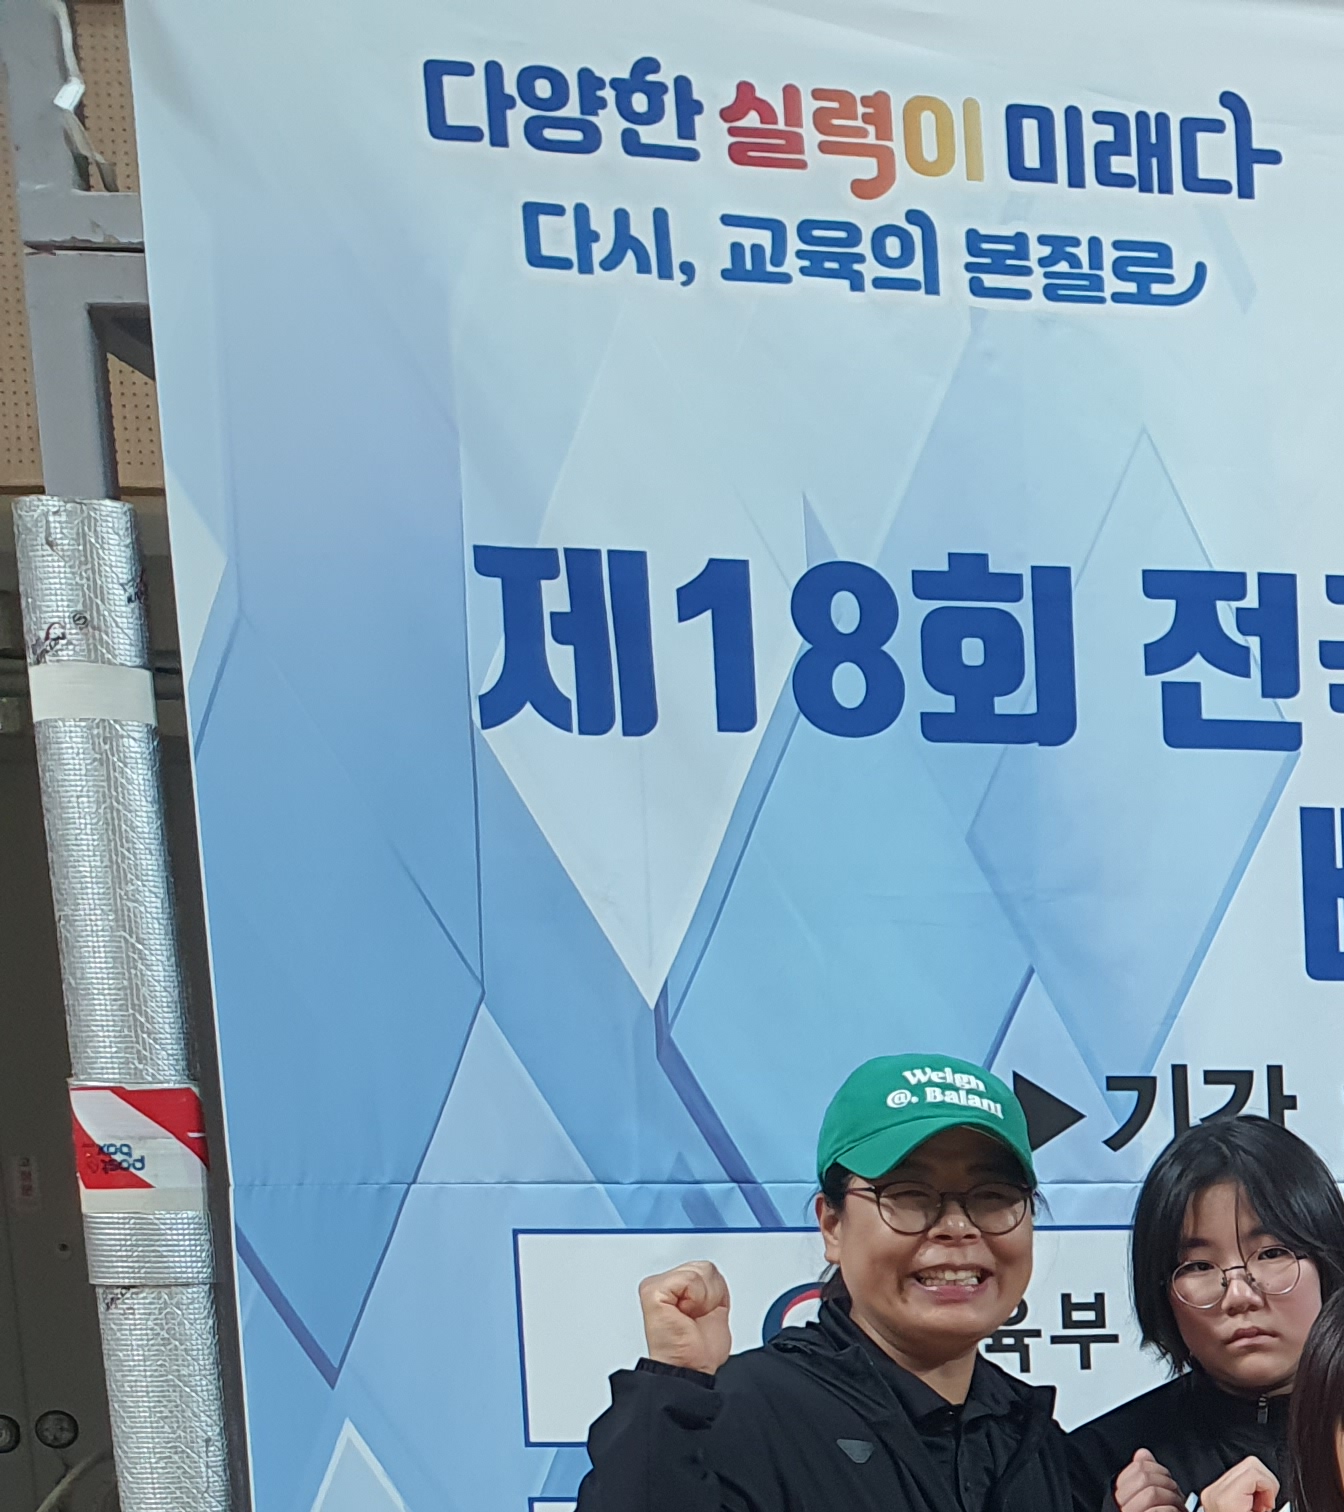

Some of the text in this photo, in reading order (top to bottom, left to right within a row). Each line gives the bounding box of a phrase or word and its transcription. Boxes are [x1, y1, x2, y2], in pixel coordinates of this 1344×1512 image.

[421, 55, 1284, 201] 다양한 실력이 미래다
[521, 200, 1208, 308] 다시, 교육의 본질로
[473, 544, 1079, 748] 제18회
